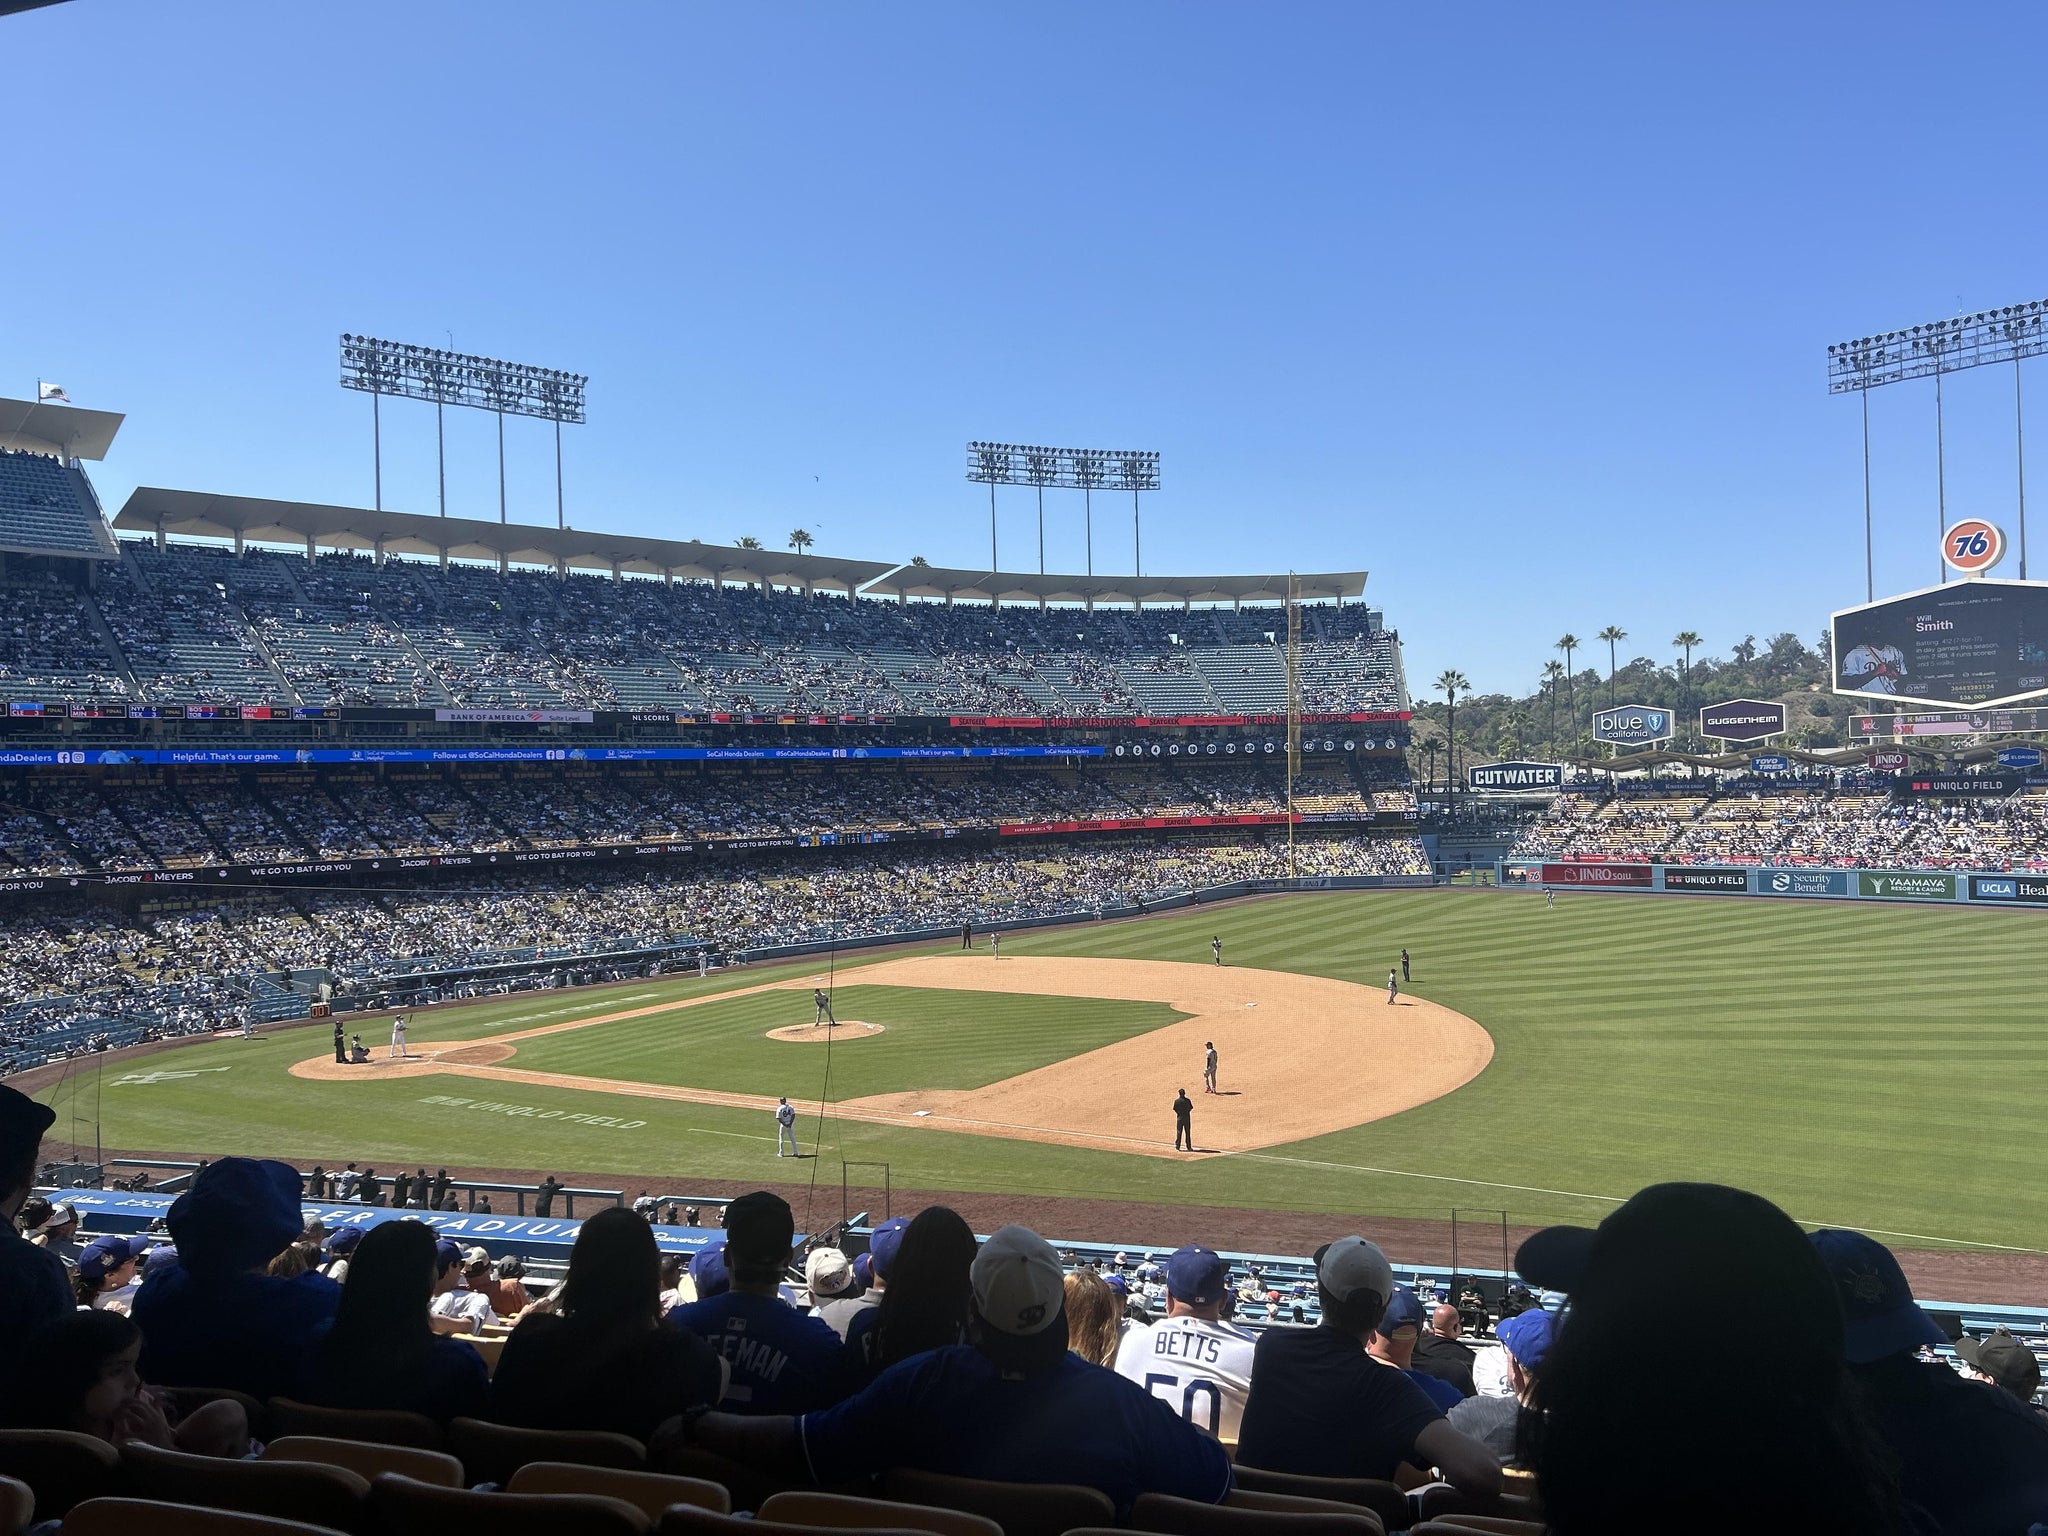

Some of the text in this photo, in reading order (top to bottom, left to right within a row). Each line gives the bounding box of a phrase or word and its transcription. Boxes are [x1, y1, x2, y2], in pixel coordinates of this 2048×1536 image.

[1953, 530, 1989, 559] 76
[1915, 620, 1953, 632] Smith
[1309, 713, 1351, 723] DODGERS
[1366, 712, 1401, 720] SEATGEEK
[1707, 716, 1777, 725] GUGGENHEIM
[958, 718, 986, 726] SEATGEEK
[1601, 714, 1643, 731] blue
[1607, 730, 1648, 738] california
[173, 752, 208, 762] Helpful.
[210, 752, 236, 761] That's
[254, 754, 281, 763] game.
[433, 751, 457, 759] Follow
[1875, 755, 1903, 766] JINRO
[1475, 769, 1555, 785] CUTWATER
[1933, 781, 2002, 791] UNIQLO FIELD
[1164, 818, 1191, 826] SEATGEEK
[636, 846, 660, 854] JACOBY
[400, 859, 430, 867] JACOBY
[440, 857, 471, 865] MEYERS
[251, 868, 266, 876] WE
[1580, 868, 1612, 883] JINRO
[105, 875, 142, 884] JACOBY
[154, 872, 194, 881] MEYERS
[1684, 875, 1744, 885] UNIQLO FIELD
[1793, 874, 1831, 885] Security
[0, 881, 44, 891] FOR YOU
[1793, 883, 1827, 892] Benefit
[1981, 884, 2048, 896] UCLA Heal
[467, 1101, 647, 1129] UNIQLO FIELD
[1155, 1331, 1221, 1364] BETTS
